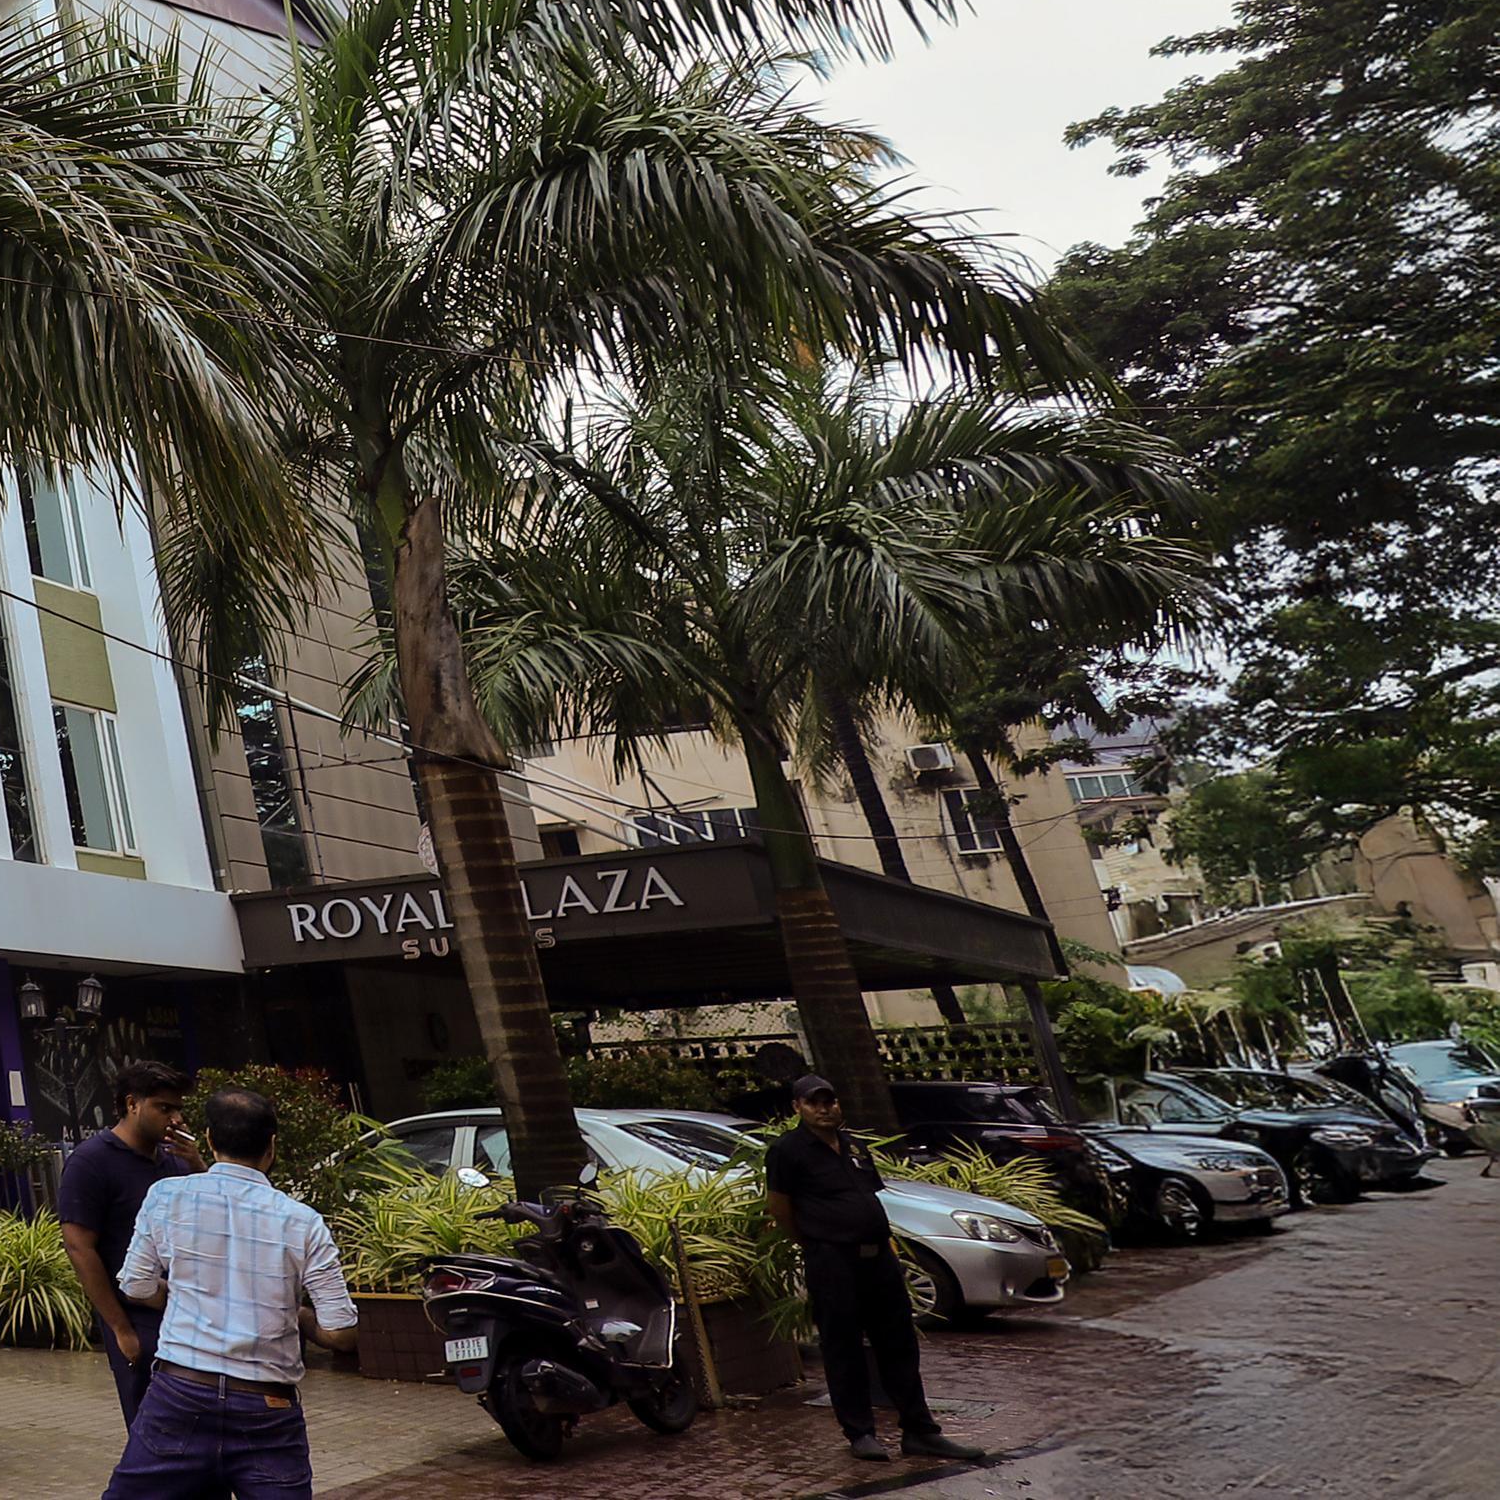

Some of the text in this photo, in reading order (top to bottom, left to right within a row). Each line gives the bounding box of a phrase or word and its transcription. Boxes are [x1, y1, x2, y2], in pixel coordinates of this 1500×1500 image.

[286, 866, 686, 942] ROYAL LAZA
[401, 926, 556, 961] SUS
